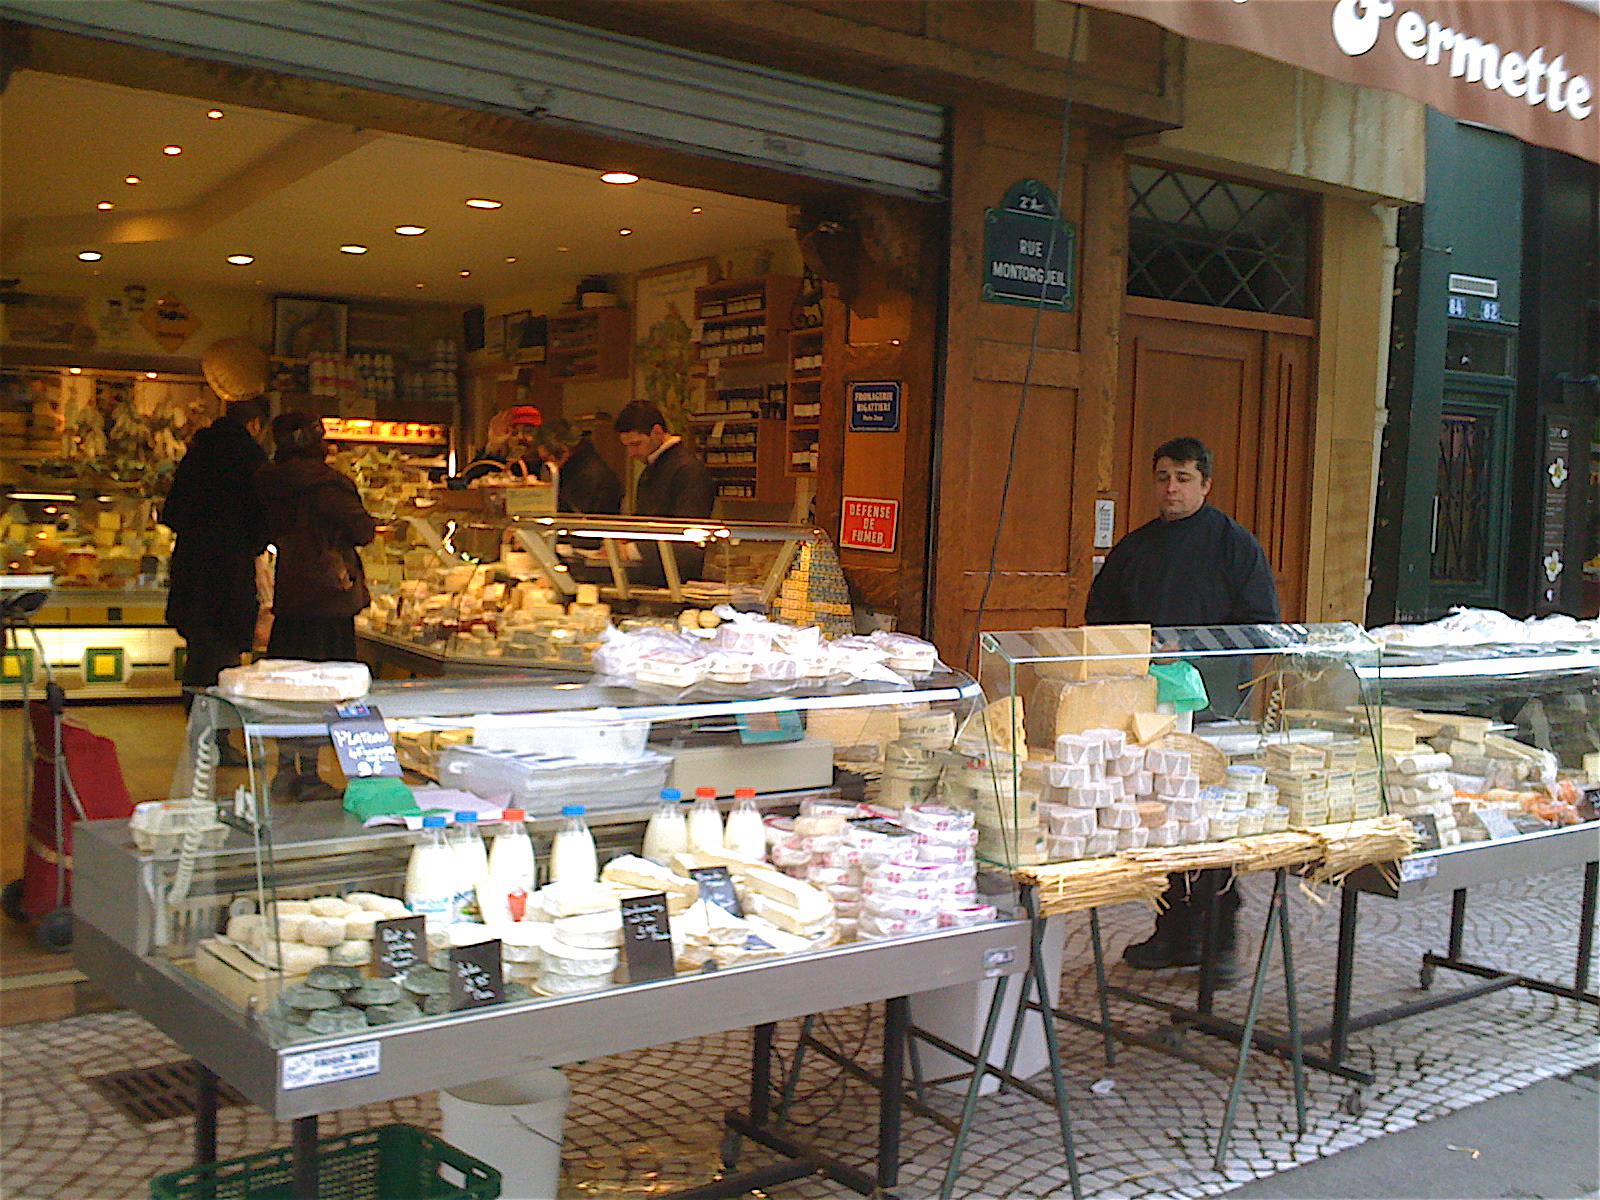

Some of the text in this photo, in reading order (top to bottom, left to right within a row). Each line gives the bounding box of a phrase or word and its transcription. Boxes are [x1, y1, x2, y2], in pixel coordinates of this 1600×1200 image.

[1019, 239, 1043, 258] RUE
[863, 517, 876, 531] DE
[852, 529, 884, 545] FUMER
